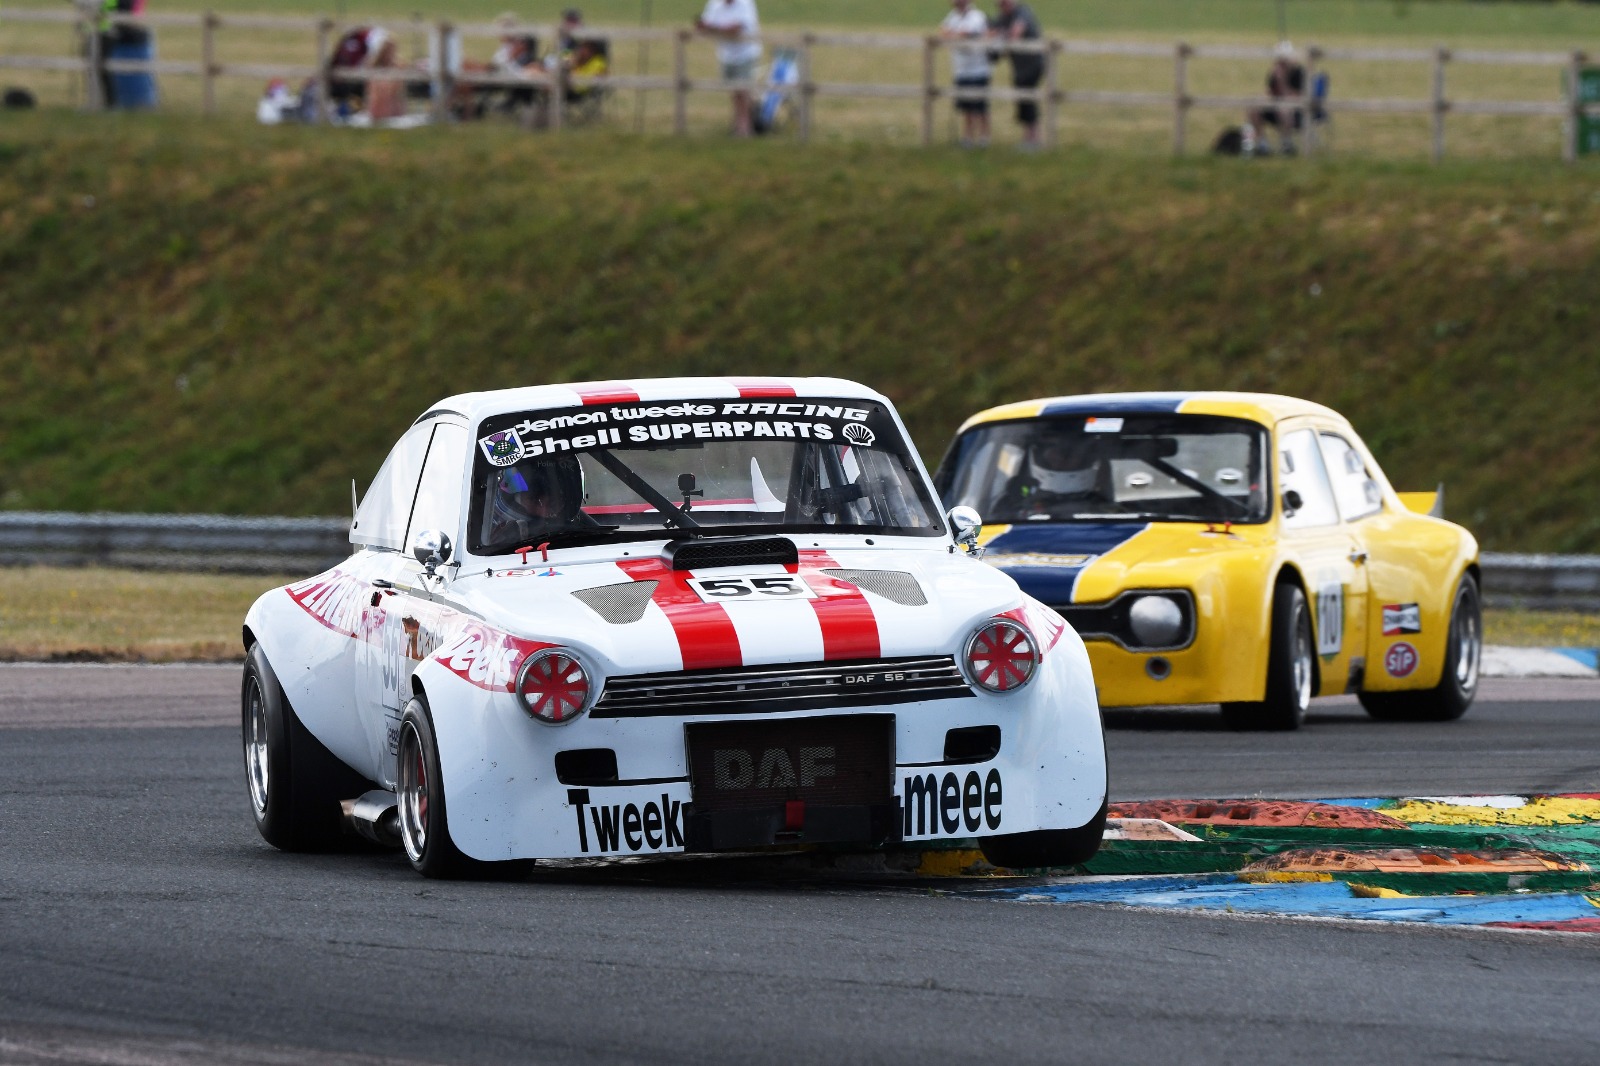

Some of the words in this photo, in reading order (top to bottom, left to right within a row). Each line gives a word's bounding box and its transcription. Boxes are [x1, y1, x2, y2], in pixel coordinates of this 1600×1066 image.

[610, 402, 716, 420] tweeks
[722, 403, 870, 422] RACING
[522, 428, 621, 459] Shell
[629, 421, 834, 442] SUPERPARTS
[495, 453, 521, 467] SMRC
[698, 577, 804, 597] 55
[1389, 647, 1413, 671] STP
[845, 674, 875, 684] DAF
[714, 746, 836, 789] DAF
[904, 768, 1002, 836] meee
[567, 788, 687, 852] Tweek
